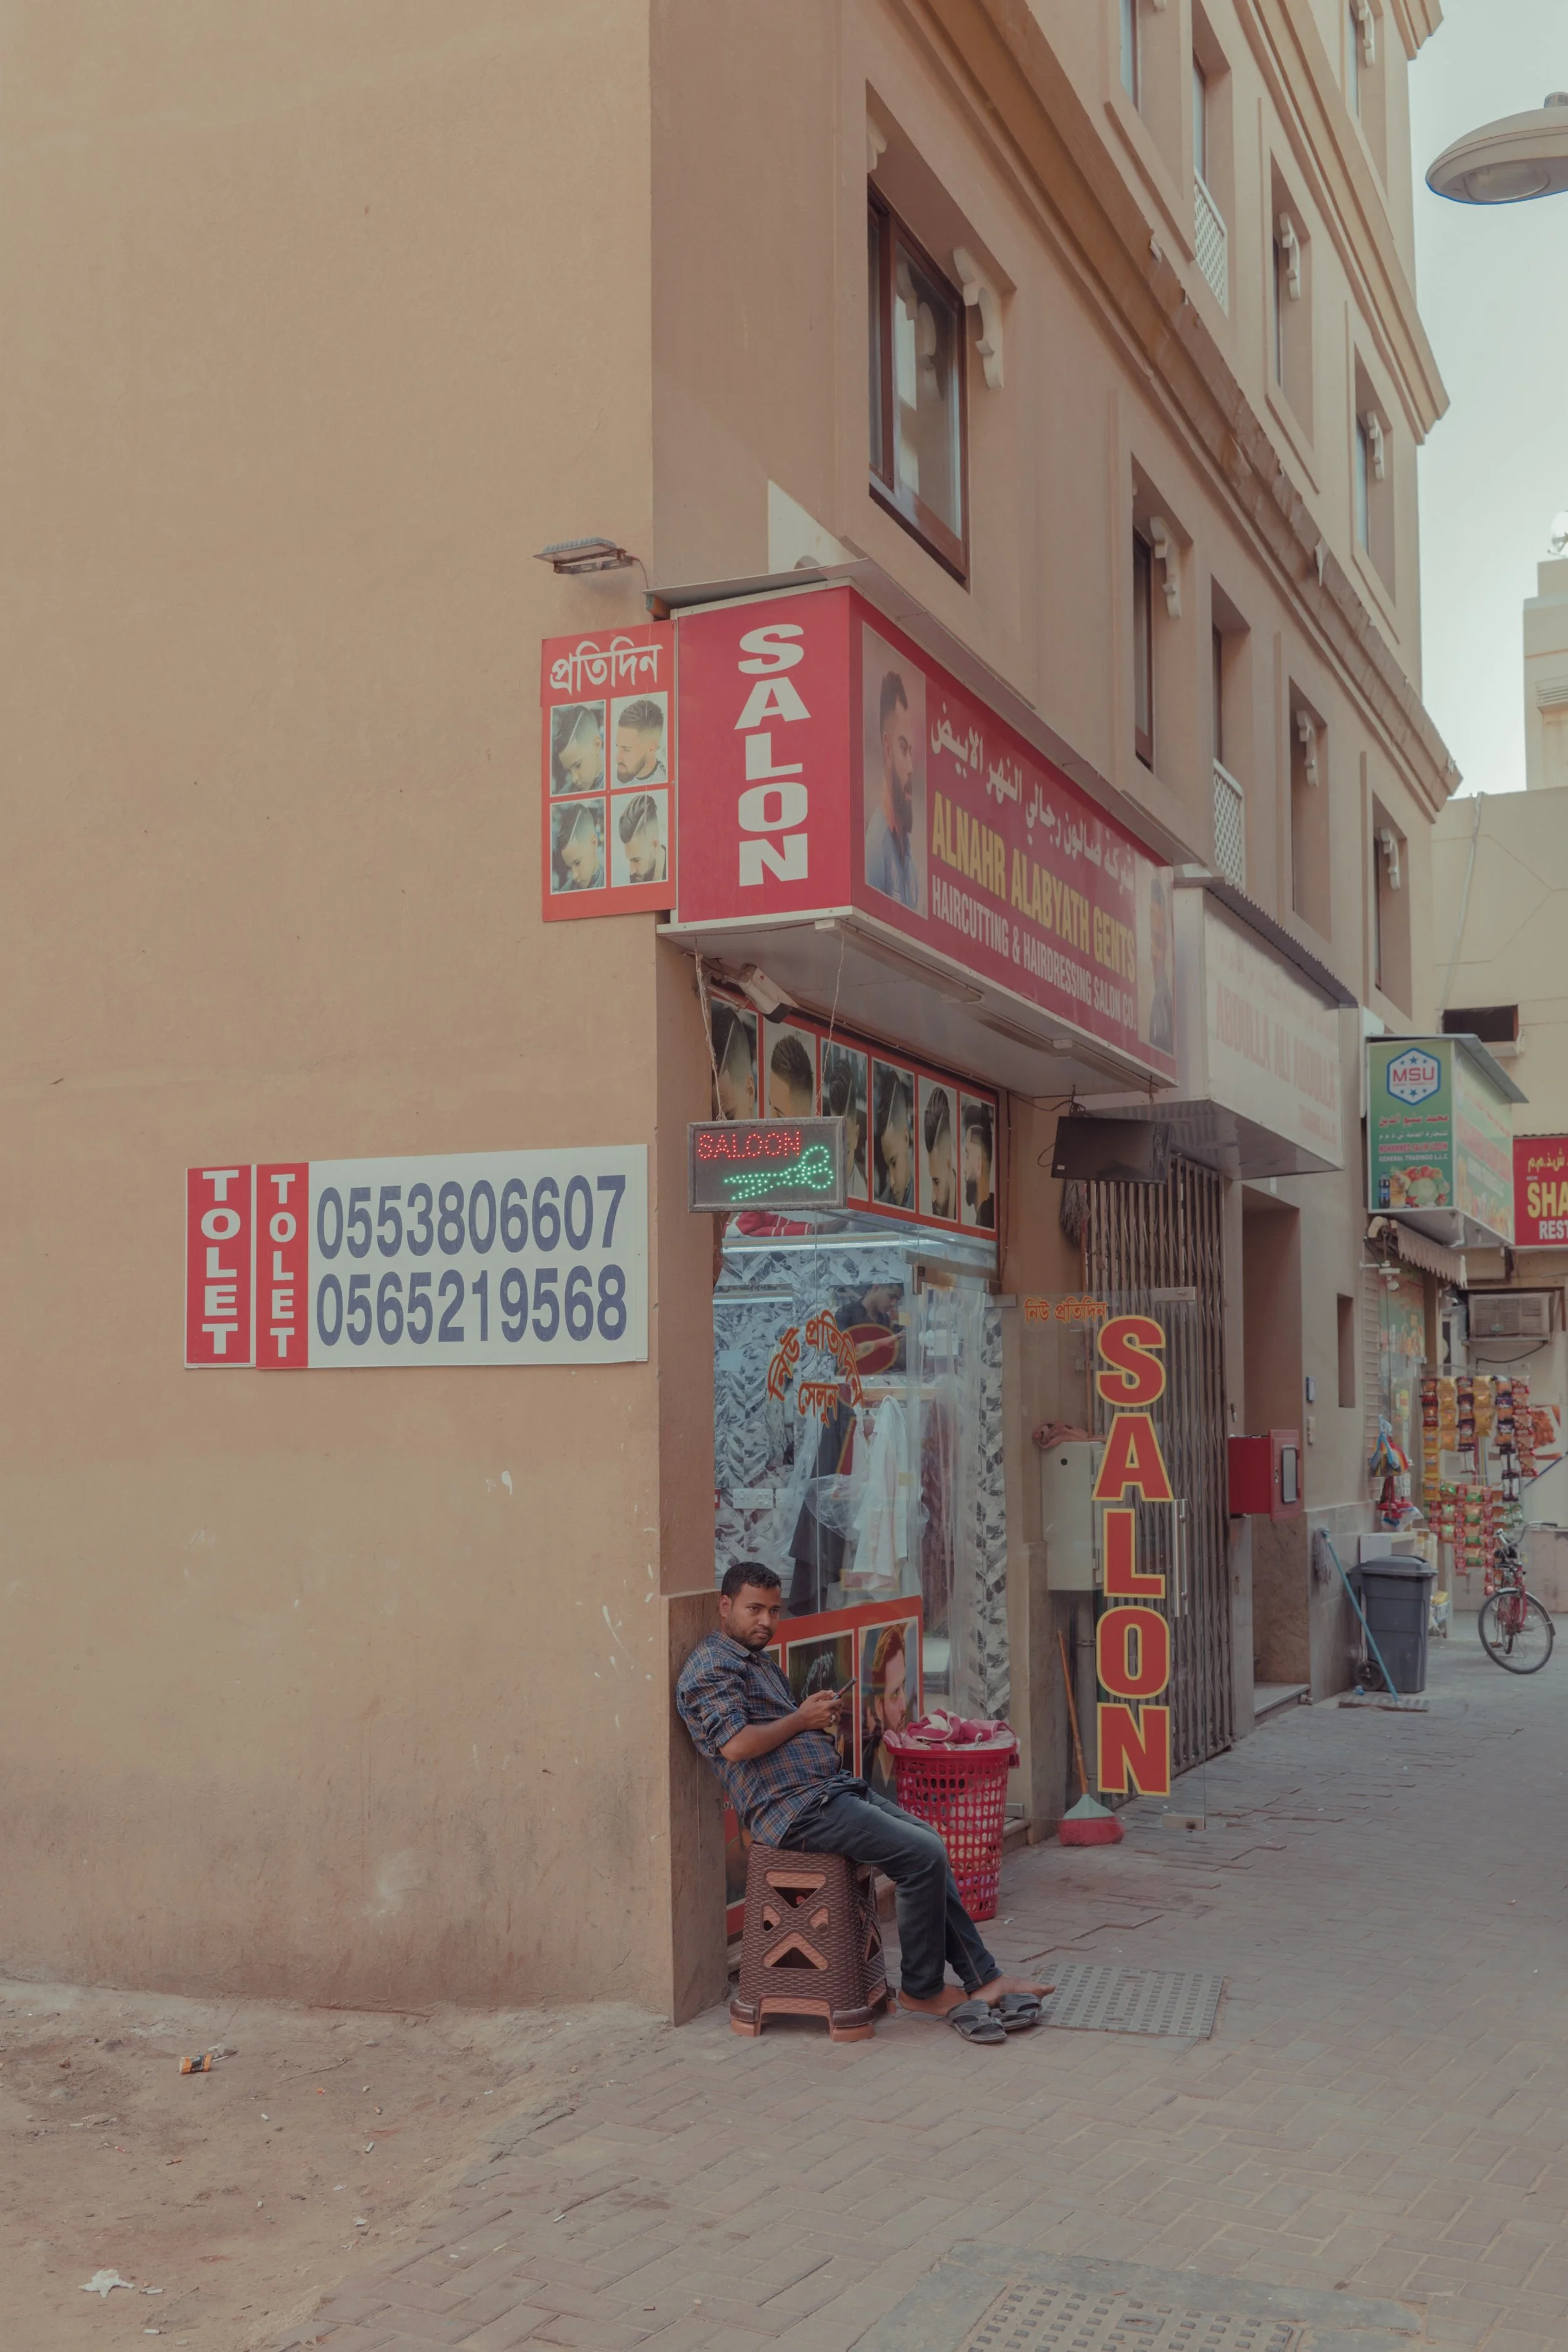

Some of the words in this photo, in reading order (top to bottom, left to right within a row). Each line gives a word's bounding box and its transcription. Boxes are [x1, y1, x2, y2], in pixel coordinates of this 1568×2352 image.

[549, 636, 663, 696] প্রতিদিন
[734, 623, 811, 887] SALON
[931, 702, 983, 778] الابيض
[987, 757, 1022, 805] النهر
[1025, 781, 1061, 848] رجالي
[1064, 811, 1101, 867] صالون
[1104, 830, 1135, 895] شركة
[932, 791, 1007, 901] ALNAHR
[1011, 847, 1090, 954] ALABYATH
[1094, 905, 1135, 983] GENTS
[932, 874, 1009, 957] HAIRCUTTING
[1012, 926, 1020, 966] &
[1024, 934, 1092, 1005] HAIRDRESSING
[1094, 976, 1121, 1022] SALON
[1122, 997, 1137, 1031] CO.
[1393, 1067, 1434, 1082] MSU
[698, 1130, 801, 1159] SALOON
[317, 1174, 626, 1259] 0553806607
[316, 1264, 627, 1346] 0565219568
[1023, 1297, 1051, 1325] নিউ
[1054, 1295, 1108, 1325] প্রতিদিন
[767, 1327, 801, 1402] নিউ
[805, 1309, 865, 1408] প্রতিদিন
[798, 1382, 839, 1428] সেলুন
[1091, 1314, 1174, 1797] SALON
